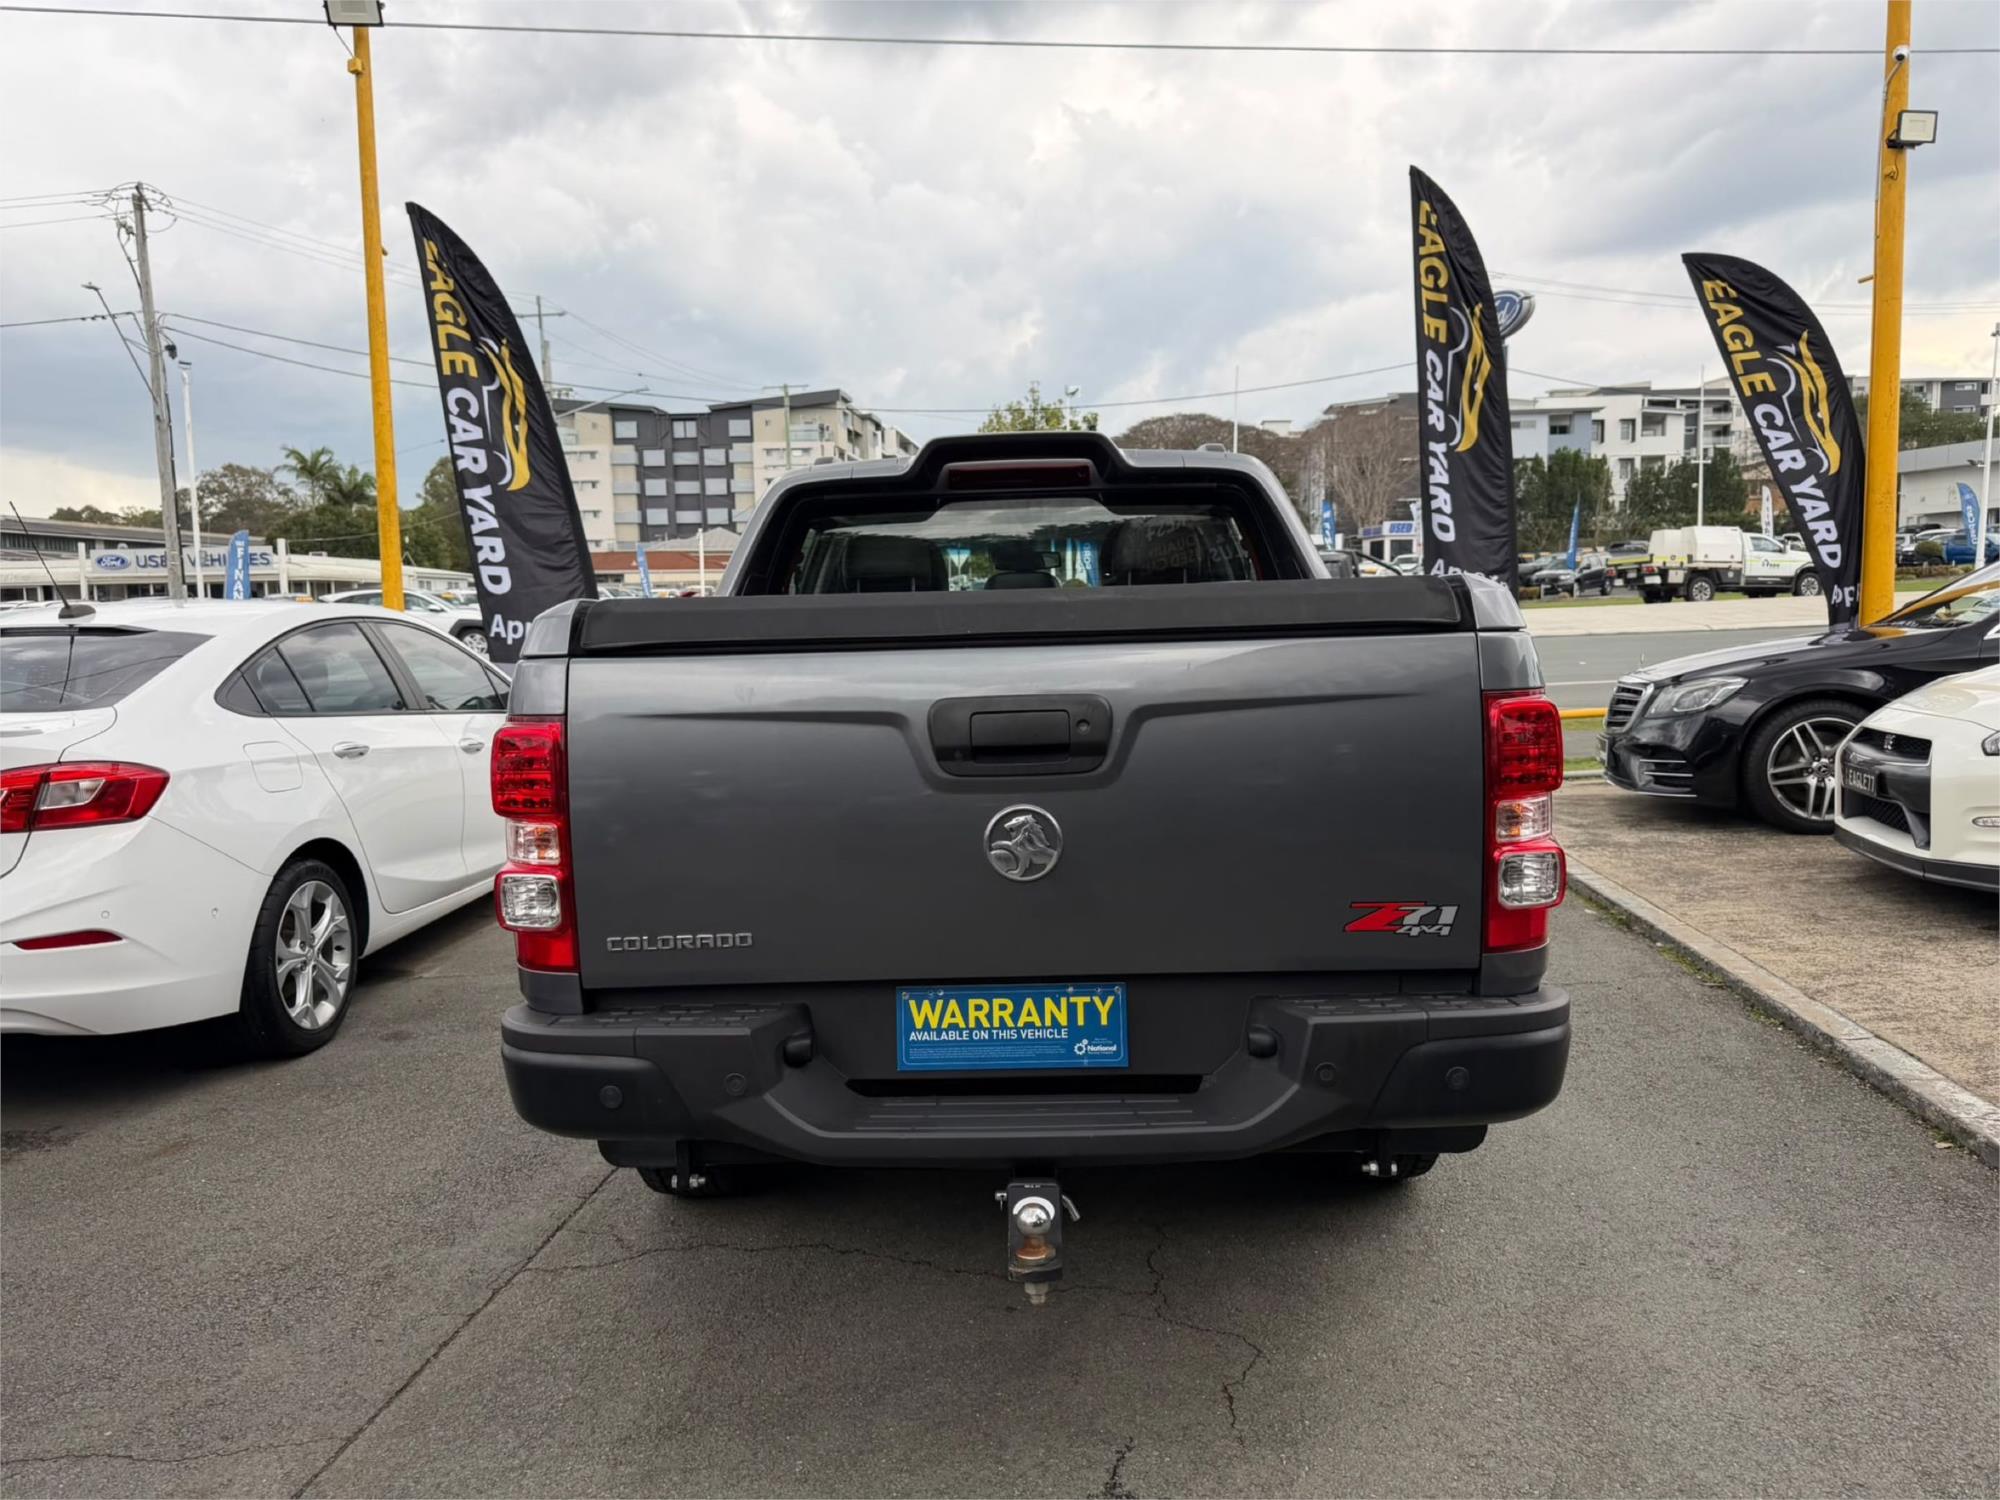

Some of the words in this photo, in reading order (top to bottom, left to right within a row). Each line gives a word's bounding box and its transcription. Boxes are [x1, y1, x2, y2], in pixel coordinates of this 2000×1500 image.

[423, 237, 478, 378] EAGLE
[1419, 200, 1449, 344] EAGLE
[446, 387, 488, 474] CAR
[1425, 349, 1446, 432] CAR
[1702, 280, 1777, 397] EAGLE
[1753, 403, 1807, 473] CAR
[1789, 474, 1842, 568] YARD
[1428, 442, 1456, 542] YARD
[99, 555, 123, 568] Ford
[136, 554, 168, 569] USE
[187, 551, 271, 568] VEHIES
[463, 484, 512, 595] YARD
[606, 932, 753, 951] COLORADO
[1344, 901, 1459, 933] Z71
[908, 995, 1116, 1029] WARRANTY
[909, 1030, 970, 1042] AVAILABLE
[972, 1029, 989, 1040] ON
[992, 1029, 1018, 1040] THIS
[1020, 1028, 1069, 1039] VEHICLE
